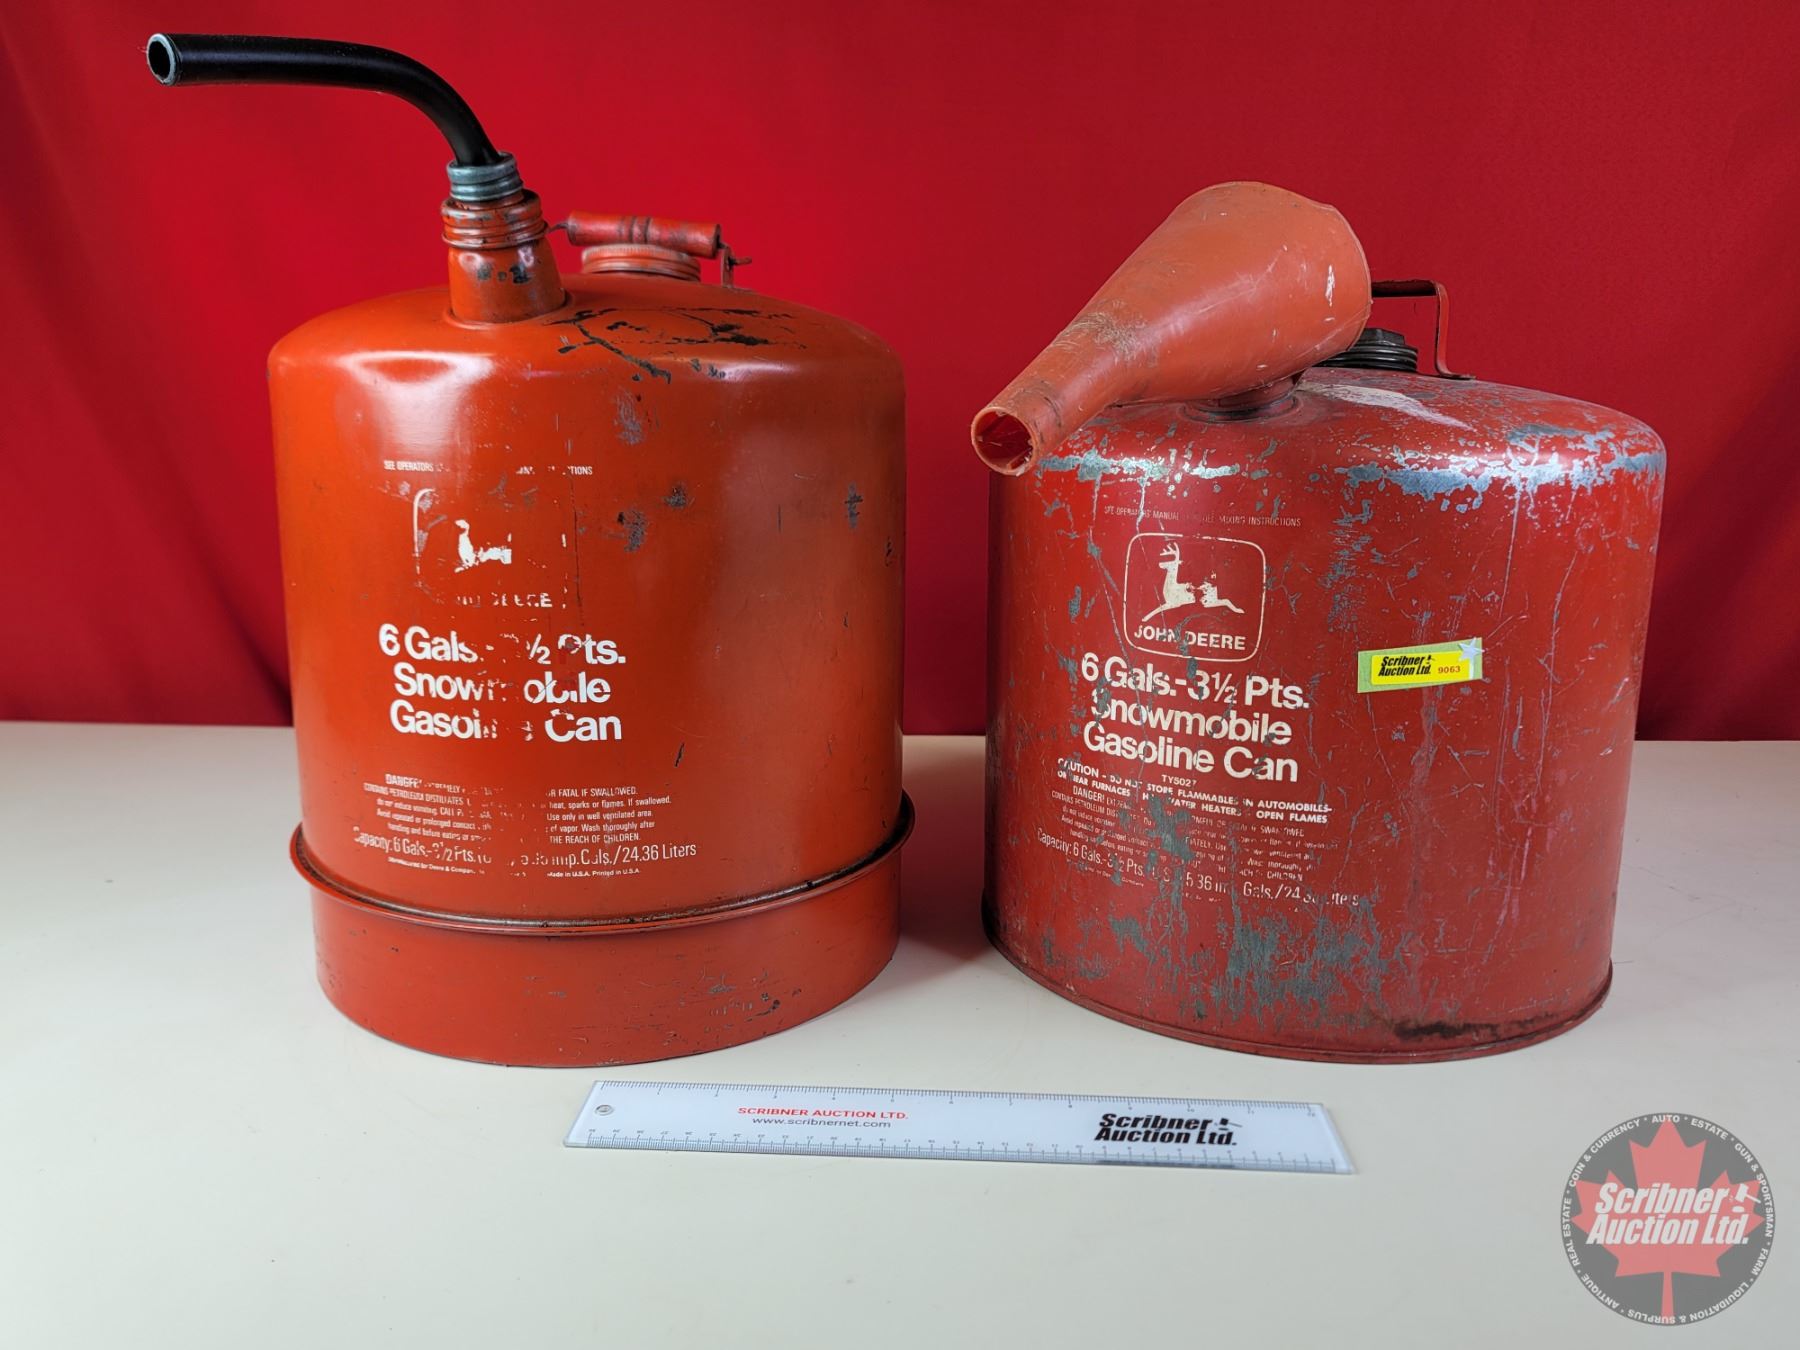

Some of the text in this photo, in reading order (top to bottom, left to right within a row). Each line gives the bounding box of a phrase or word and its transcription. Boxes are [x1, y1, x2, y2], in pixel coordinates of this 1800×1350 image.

[379, 623, 399, 657] 6
[1186, 630, 1247, 651] DEERE
[1381, 656, 1425, 667] Scribner
[1437, 666, 1461, 674] 9063
[1378, 665, 1431, 676] Auction Ltd.
[1081, 651, 1100, 682] 6
[1245, 675, 1310, 710] Pts.
[1091, 687, 1293, 746] Snowmobile
[545, 708, 622, 743] Can
[1083, 720, 1299, 783] Gasoline Can
[558, 788, 579, 798] FATAL
[581, 788, 589, 797] IF
[1091, 780, 1131, 797] FURNACES
[639, 820, 655, 828] after
[1256, 810, 1284, 821] OPEN
[1289, 812, 1328, 824] FLAMES
[565, 834, 589, 844] REACH
[591, 834, 601, 843] OF
[661, 842, 697, 860] Liters
[738, 1107, 908, 1120] SCRIBNER AUCTION LTD.
[1099, 1113, 1213, 1130] Scribner
[752, 1117, 891, 1128] www.scribnernet.com
[1094, 1128, 1238, 1146] Auction Ltd.
